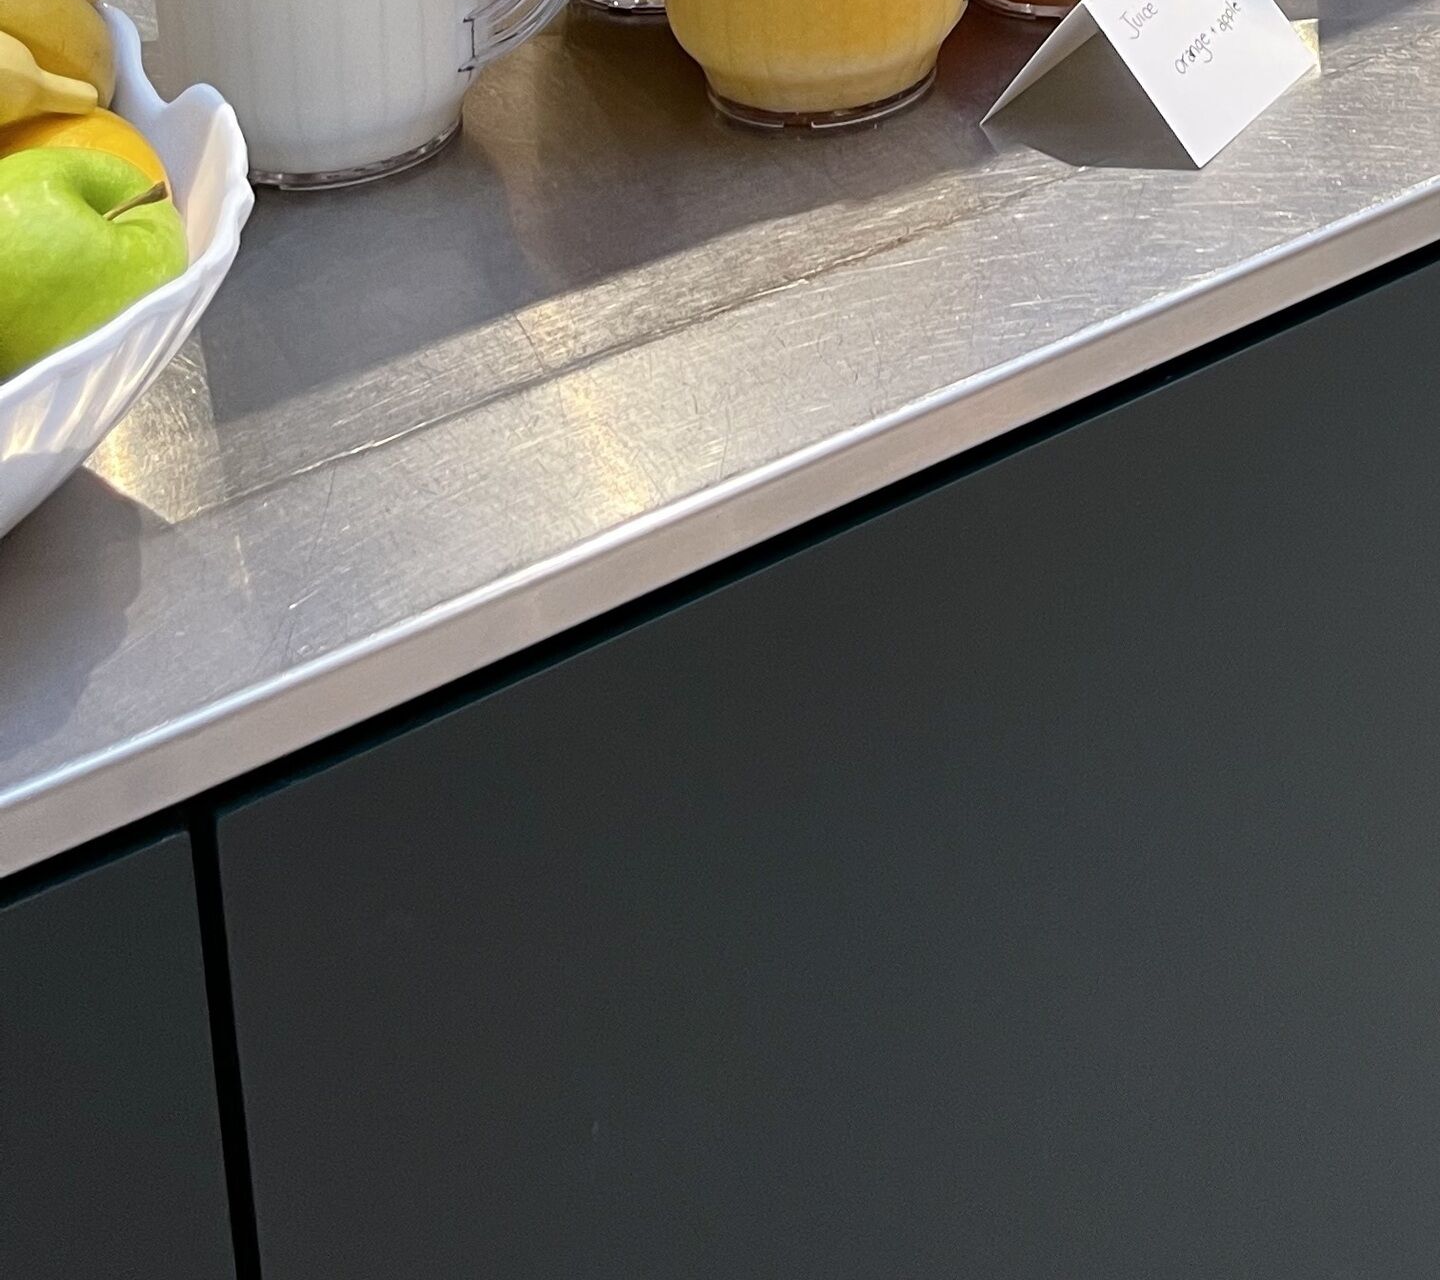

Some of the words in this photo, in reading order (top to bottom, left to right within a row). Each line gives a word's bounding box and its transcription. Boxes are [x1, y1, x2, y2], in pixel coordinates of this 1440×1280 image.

[1119, 2, 1159, 40] Juice
[1174, 32, 1214, 74] orange
[1216, 0, 1242, 32] apple
